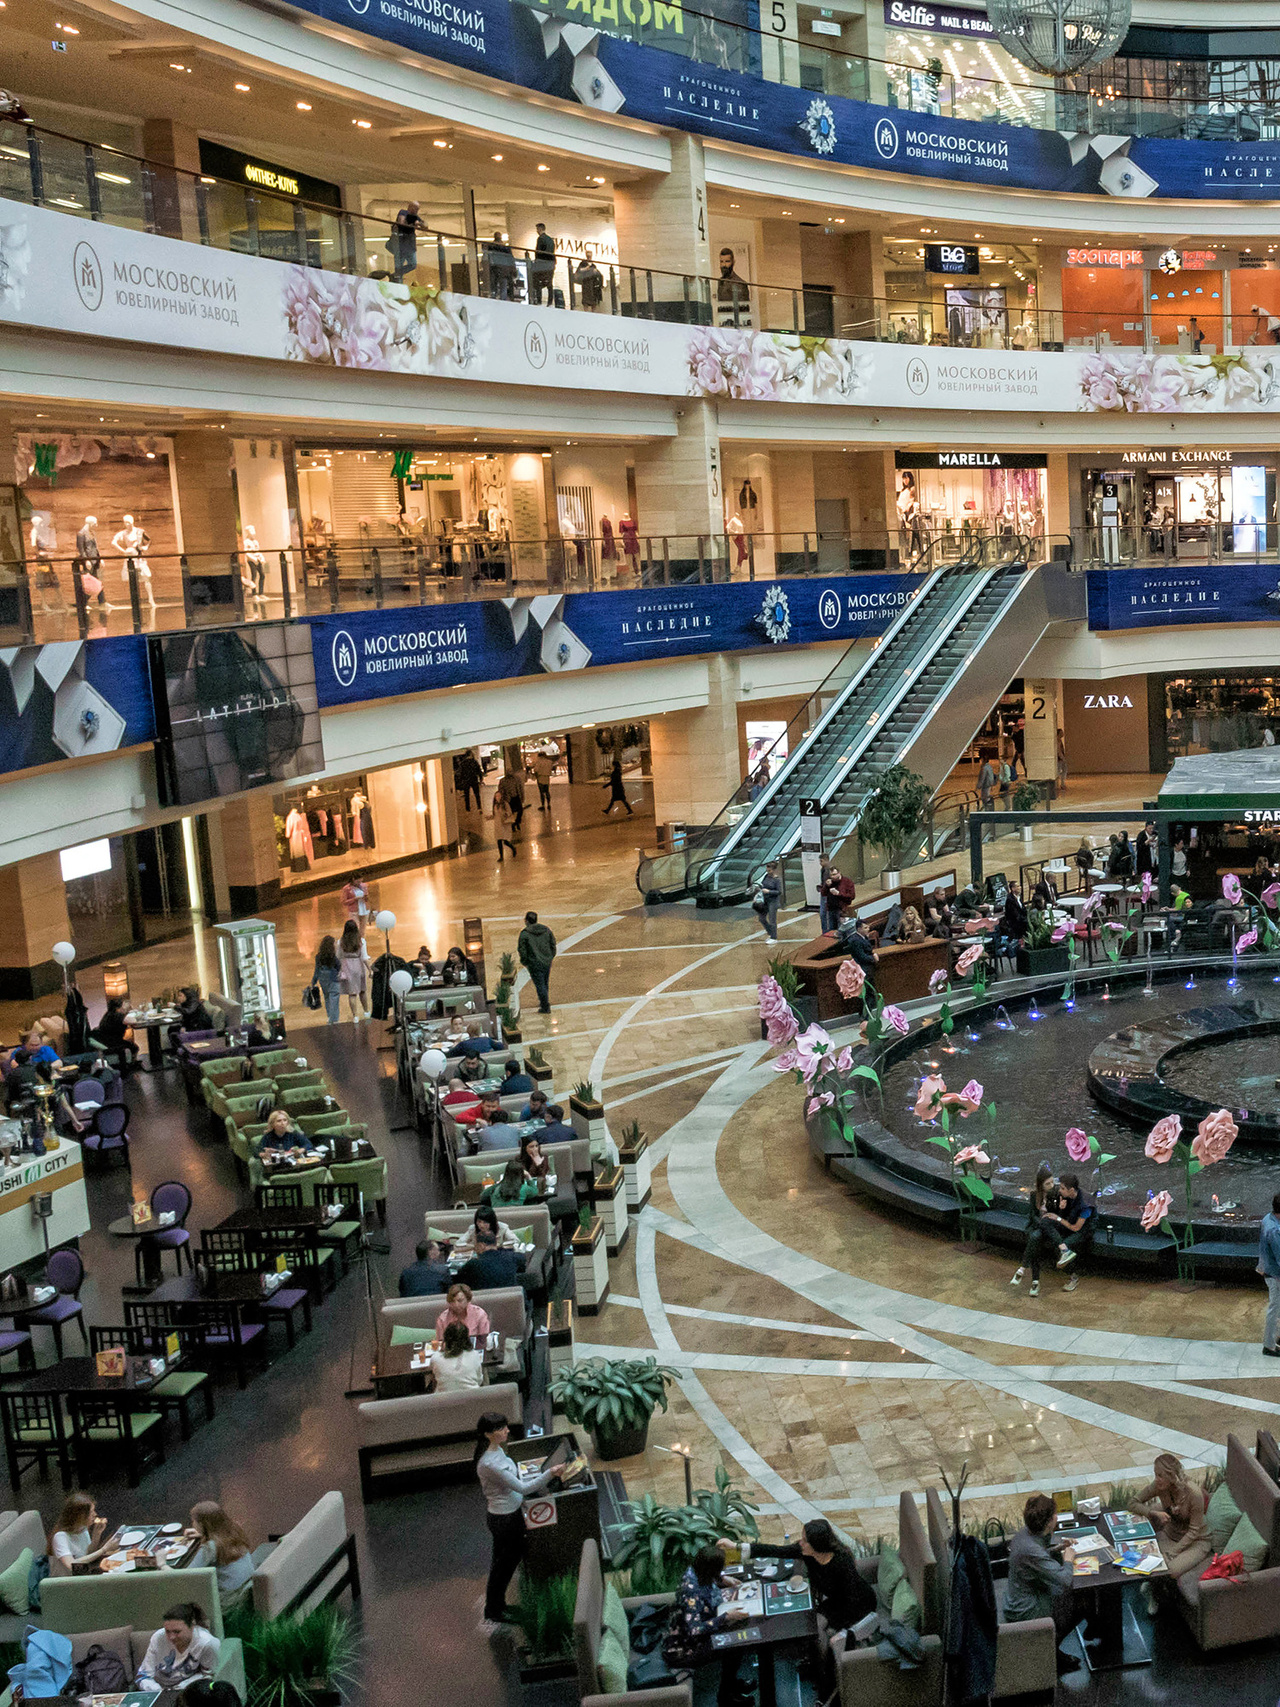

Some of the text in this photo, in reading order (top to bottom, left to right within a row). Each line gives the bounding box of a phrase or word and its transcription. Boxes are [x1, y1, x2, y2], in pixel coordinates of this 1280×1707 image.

[771, 2, 786, 33] 5
[890, 2, 935, 26] Selfie
[941, 17, 961, 29] NAIL
[962, 20, 969, 30] &
[380, 1, 487, 54] ЮВЕЛИРНЫЙ ЗАВОД
[680, 75, 741, 97] ДРАГОЦЕННОЕ
[663, 86, 759, 120] НАСЛЕДИЕ
[906, 130, 1008, 156] МОСКОВСКИЙ
[906, 146, 1008, 171] ЮВЕЛИРНЫЙ ЗАВОД
[245, 164, 299, 195] ФИТНЕС-КЛУБ
[697, 206, 706, 241] 4
[552, 237, 618, 256] ИЛИСТИК
[1066, 248, 1144, 269] зоопарк
[113, 261, 237, 302] МОСКОВСКИЙ
[115, 289, 239, 327] ЮВЕЛИРНЫЙ ЗАВОД
[554, 333, 650, 356] МОСКОВСКИЙ
[556, 353, 650, 373] ЮВЕЛИРНЫЙ ЗАВОД
[937, 365, 1038, 381] МОСКОВСКИЙ
[937, 381, 1038, 395] ЮВЕЛИРНЫЙ ЗАВОД
[938, 453, 1001, 466] MARELLA
[1122, 449, 1233, 462] ARMANI EXCHANGE
[1106, 484, 1113, 496] 3
[1144, 580, 1201, 588] ДРАГОЦЕННОЕ
[637, 602, 694, 613] ДРАГОЦЕННОЕ
[848, 591, 914, 608] МОСКОВ
[1131, 592, 1220, 605] НАСЛЕДИЕ
[622, 615, 712, 634] НАСЛЕДИЕ
[364, 623, 467, 656] МОСКОВСКИЙ
[366, 649, 469, 674] ЮВЕЛИРНЫЙ ЗАВОД
[1032, 697, 1046, 719] 2
[1084, 695, 1134, 708] ZARA
[805, 800, 815, 815] 2
[45, 1154, 68, 1173] CITY
